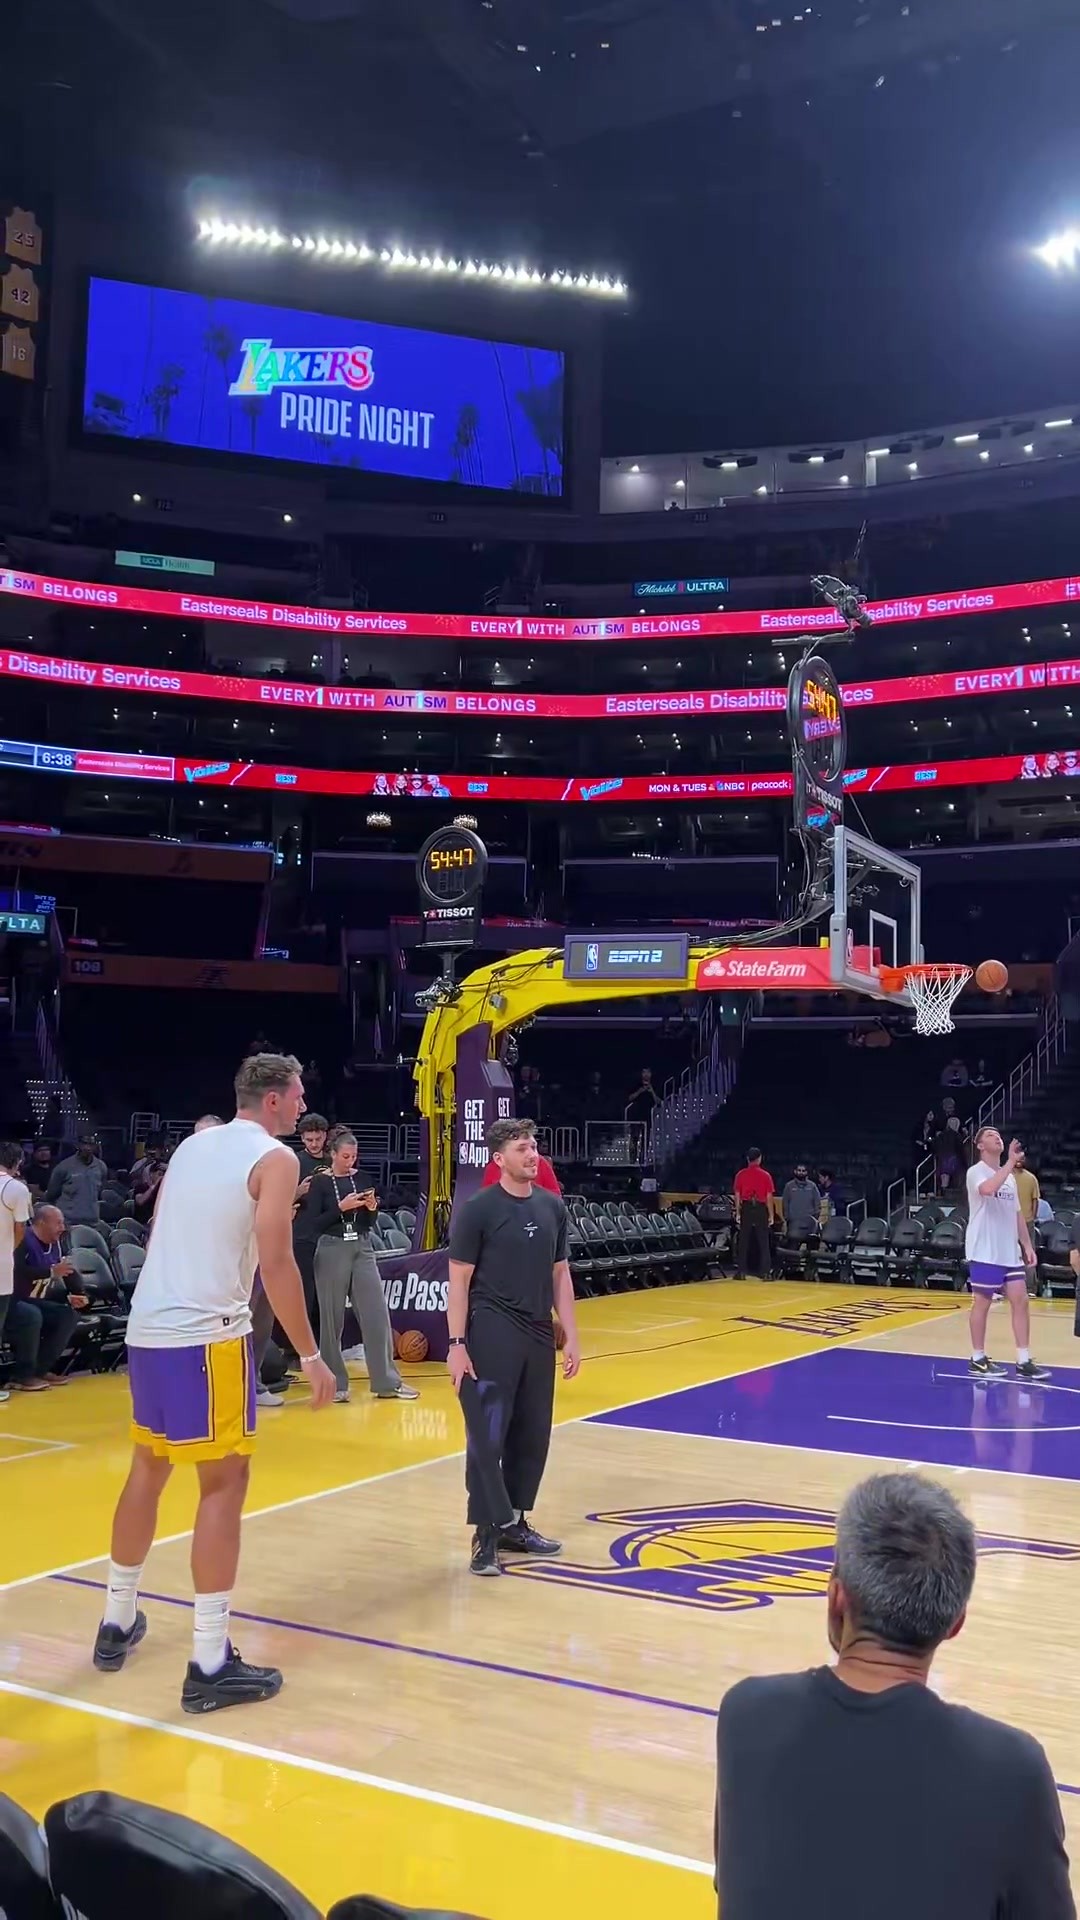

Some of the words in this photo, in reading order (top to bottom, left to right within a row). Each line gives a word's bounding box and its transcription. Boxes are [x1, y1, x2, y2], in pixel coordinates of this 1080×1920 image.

[14, 230, 35, 247] 25
[11, 287, 31, 305] 42
[11, 345, 26, 361] 16
[229, 338, 374, 395] LAKERS
[280, 391, 352, 437] PRIDE
[359, 403, 435, 449] NIGHT
[43, 582, 118, 603] BELONGS
[686, 578, 726, 593] ULTRA
[181, 597, 268, 618] Easterseals
[272, 608, 341, 629] Disability
[345, 615, 407, 630] Services
[760, 610, 846, 627] Easterseals
[927, 594, 994, 612] Services
[527, 623, 565, 635] WITH
[632, 619, 701, 634] BELONGS
[8, 655, 96, 685] Disability
[102, 668, 181, 689] Services
[1029, 664, 1080, 684] WITH
[329, 691, 375, 707] WITH
[455, 697, 537, 712] BELONGS
[606, 694, 705, 713] Easterseals
[710, 691, 787, 709] Disability
[42, 752, 73, 766] 6:38
[648, 783, 671, 793] MON
[672, 783, 680, 793] &
[681, 783, 708, 793] TUES
[724, 781, 745, 791] NBC
[751, 779, 789, 791] peacock
[914, 769, 937, 783] BEST
[467, 782, 489, 793] BEST
[430, 848, 473, 869] 54:47
[436, 907, 475, 918] TISSOT
[464, 1099, 485, 1119] GET
[497, 1097, 510, 1117] GET
[464, 1120, 485, 1141] THE
[468, 1142, 489, 1167] App
[29, 1277, 51, 1298] 77
[403, 1272, 449, 1311] Pass
